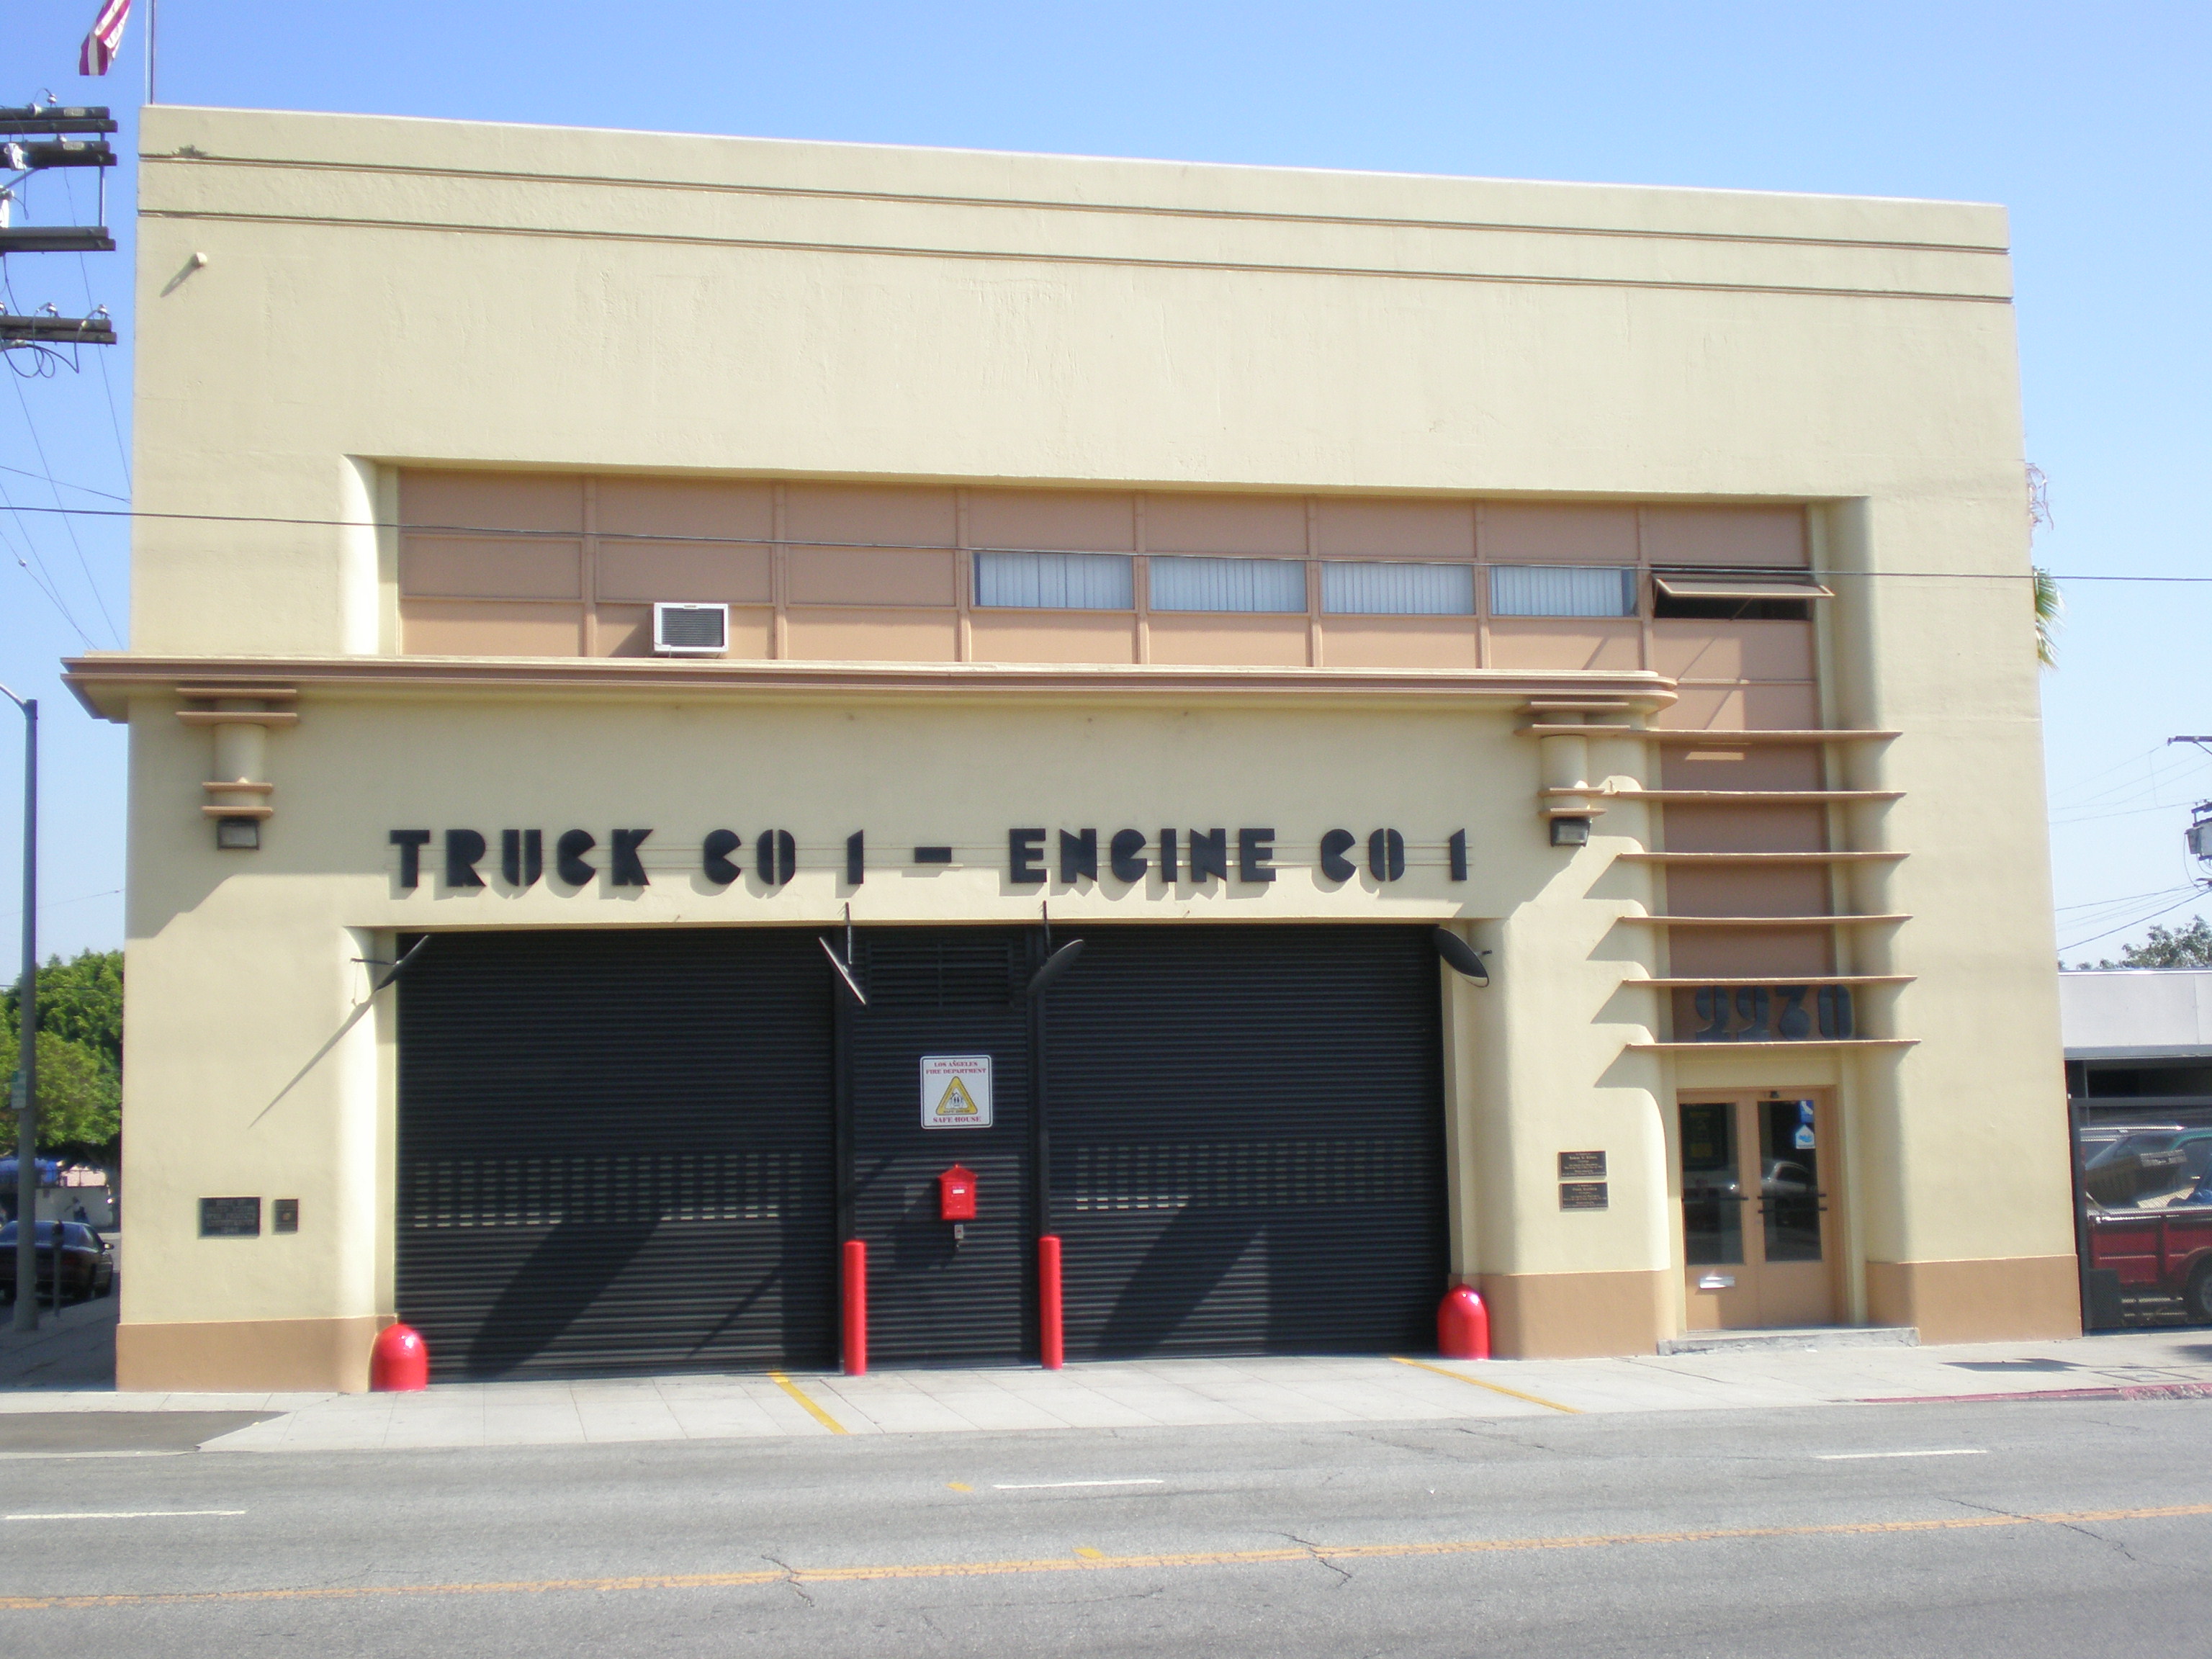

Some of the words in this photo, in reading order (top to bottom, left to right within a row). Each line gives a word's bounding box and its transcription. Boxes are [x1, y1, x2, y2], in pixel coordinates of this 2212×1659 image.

[390, 829, 653, 887] TRUCK
[703, 829, 796, 886] CO
[1009, 828, 1276, 882] ENGINE
[1321, 828, 1406, 882] CO
[1695, 984, 1853, 1041] 2230
